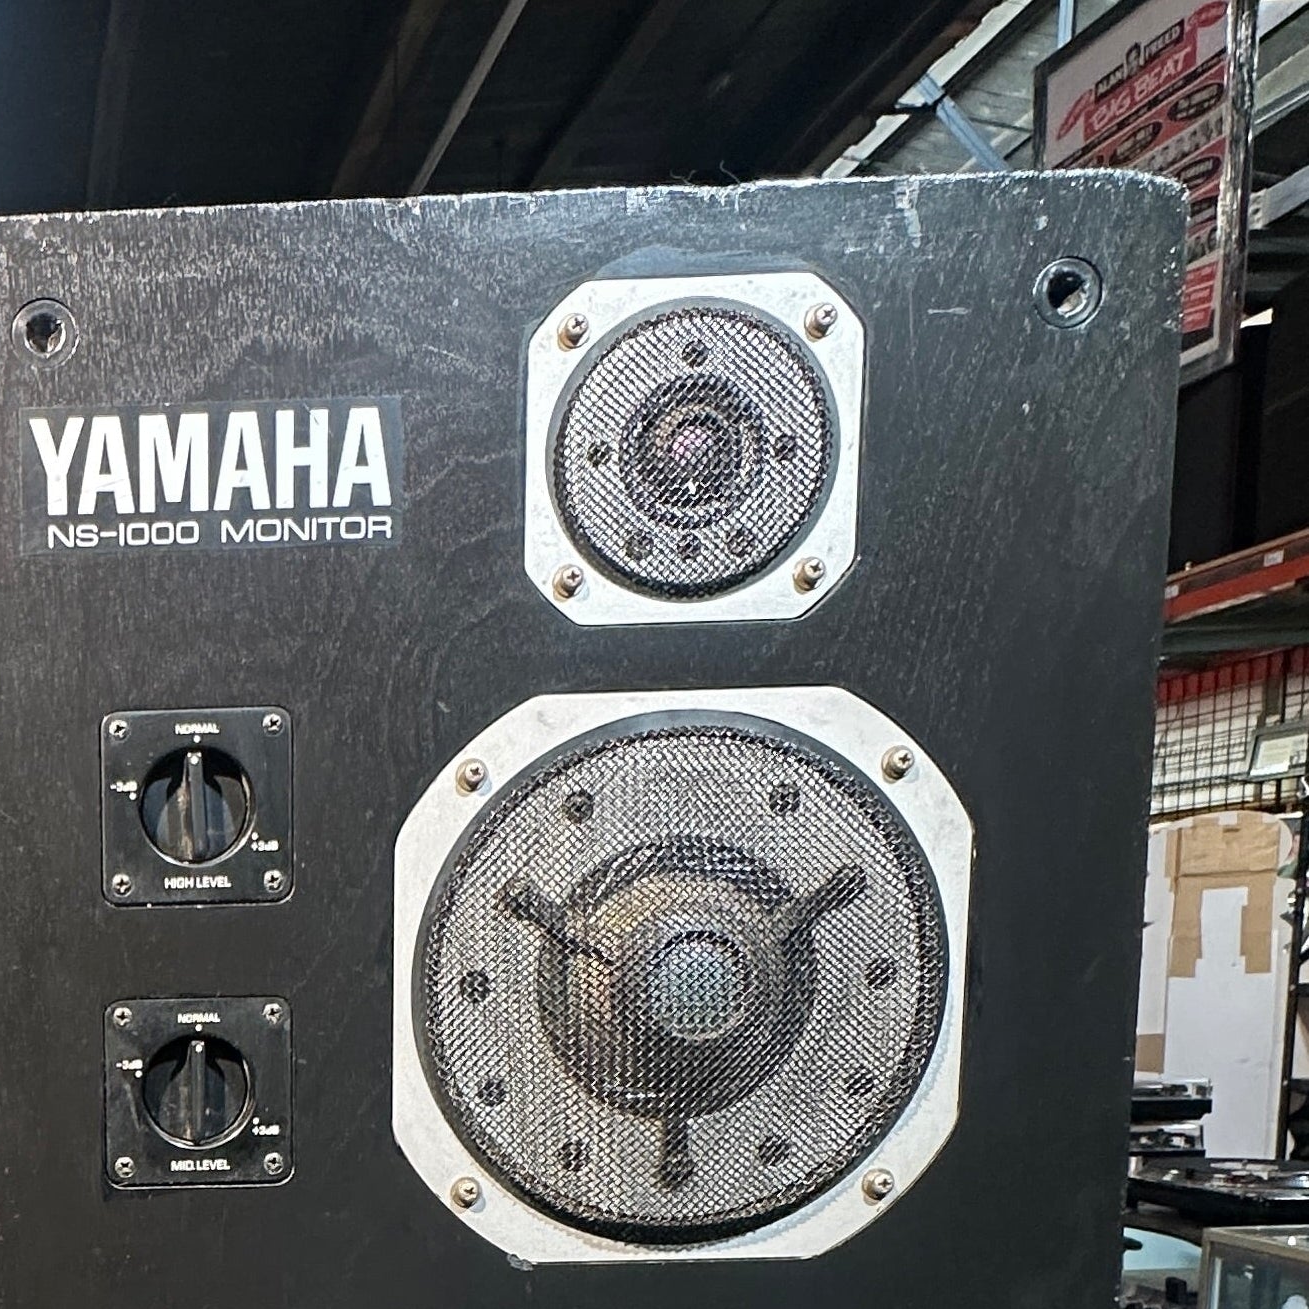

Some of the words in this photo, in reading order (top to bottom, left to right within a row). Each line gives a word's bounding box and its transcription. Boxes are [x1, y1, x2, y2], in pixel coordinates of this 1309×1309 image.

[1093, 91, 1131, 130] BIG
[1134, 47, 1192, 101] BEAT
[28, 406, 392, 516] YAMAHA
[48, 521, 200, 549] NS-1000
[221, 516, 392, 544] MONITOR
[175, 723, 220, 734] NORMAL
[164, 877, 194, 889] HIGH
[196, 876, 231, 888] LEVEL
[178, 1012, 221, 1023] NORMAL
[196, 1159, 231, 1171] LEVEL
